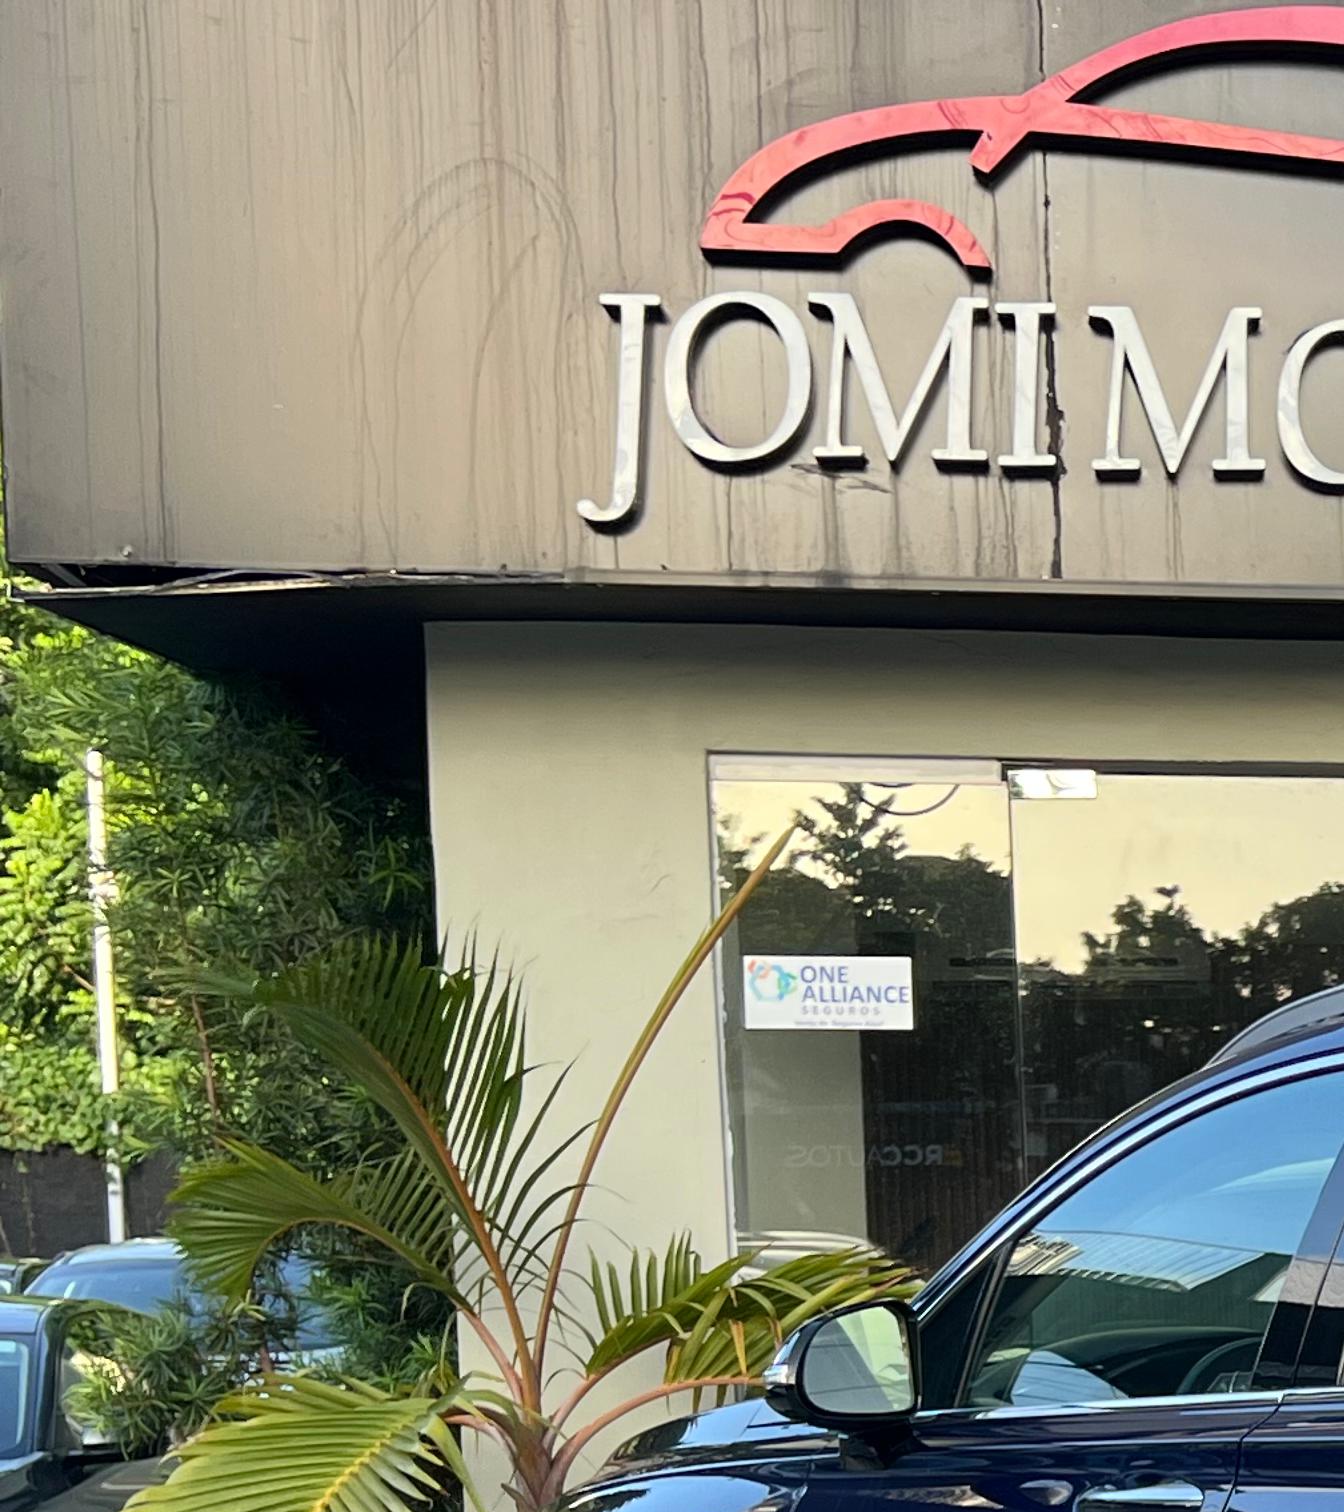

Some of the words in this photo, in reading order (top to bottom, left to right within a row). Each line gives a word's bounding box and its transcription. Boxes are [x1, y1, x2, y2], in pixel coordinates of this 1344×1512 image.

[576, 291, 1058, 531] JOMI
[800, 965, 849, 984] ONE
[801, 985, 910, 1004] ALLIANCE
[801, 1006, 881, 1016] SEGUROS
